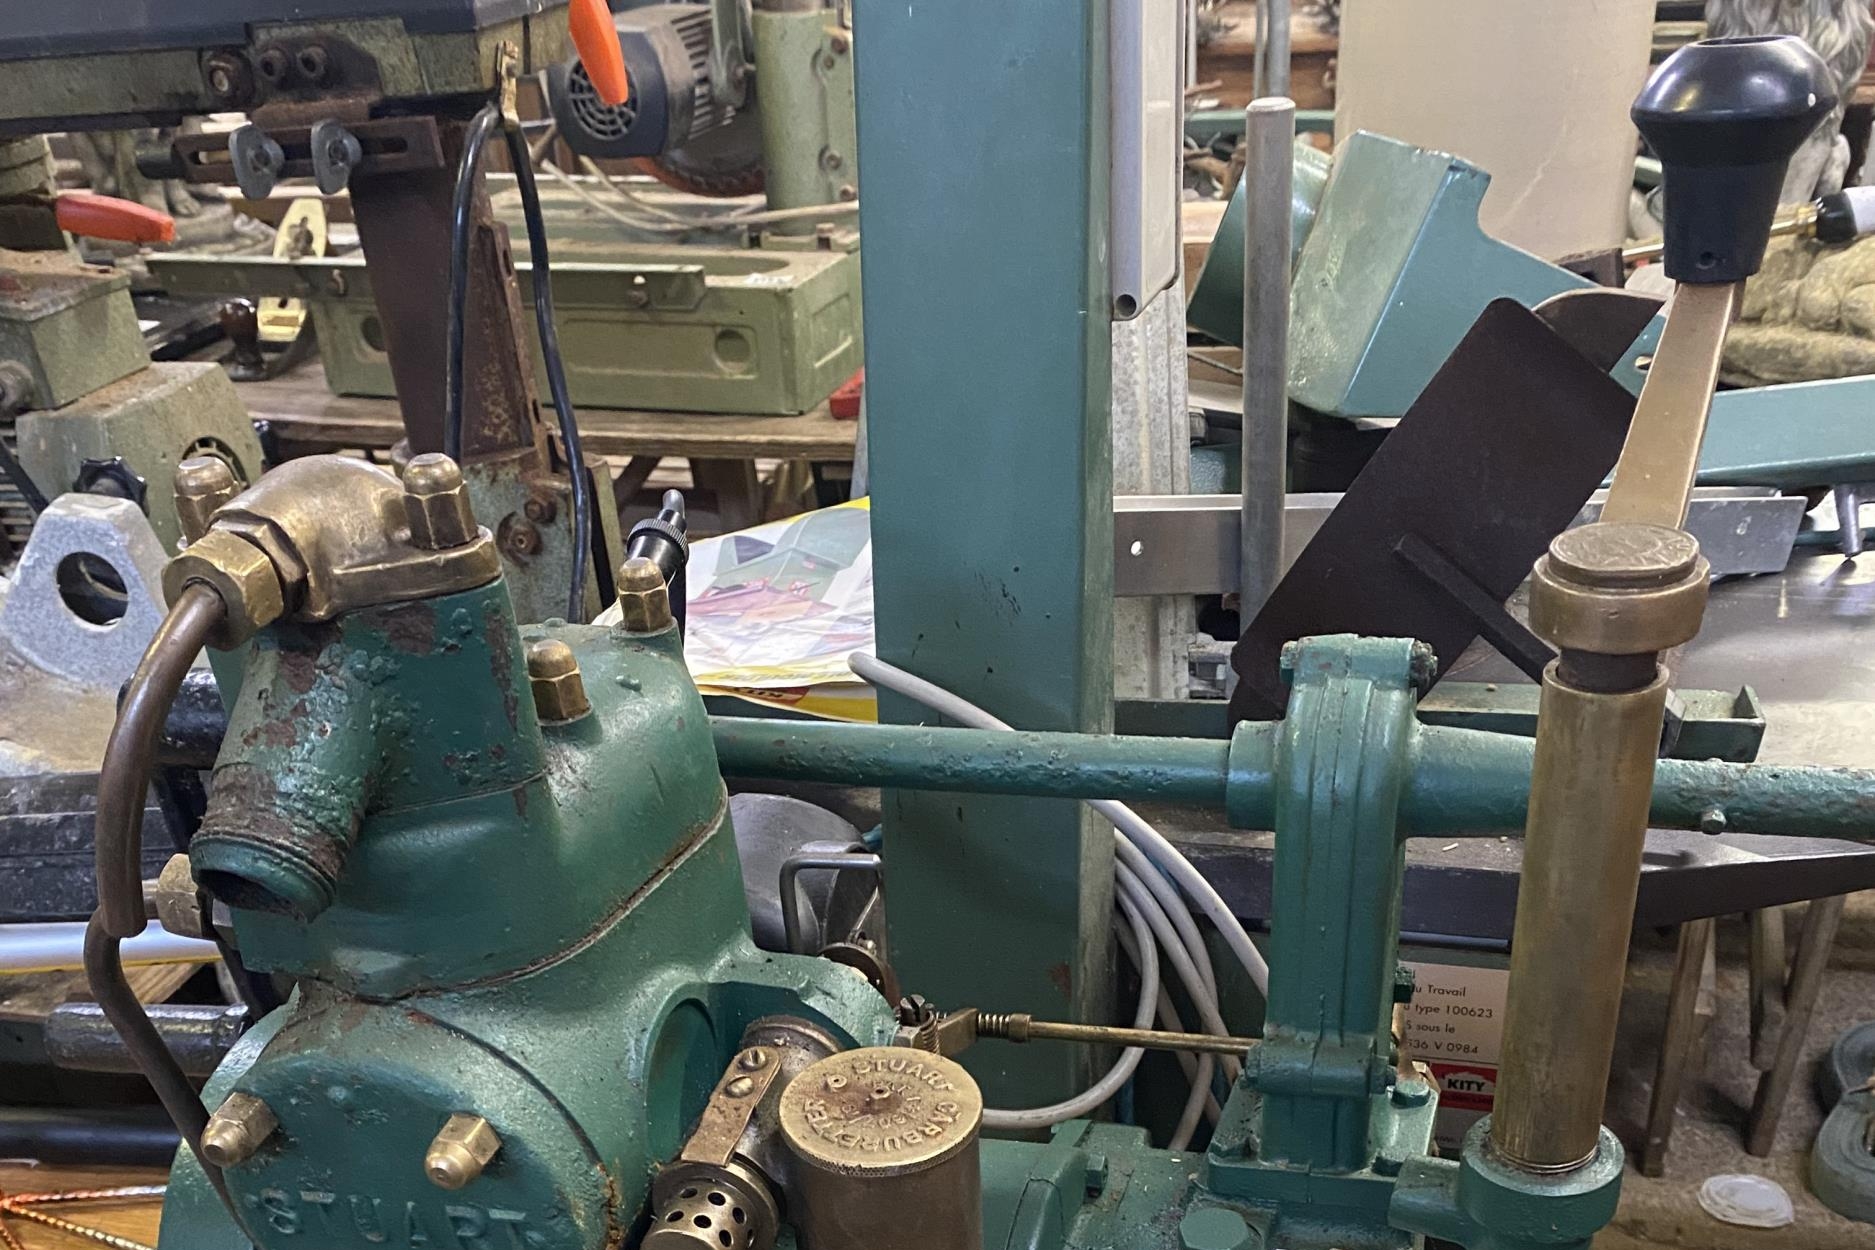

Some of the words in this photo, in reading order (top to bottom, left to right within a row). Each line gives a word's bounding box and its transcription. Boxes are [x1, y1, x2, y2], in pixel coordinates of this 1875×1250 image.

[1428, 984, 1466, 997] Travail
[1416, 1004, 1440, 1015] type
[1447, 1005, 1493, 1018] 100623
[1416, 1023, 1440, 1033] sous
[1445, 1023, 1455, 1033] le
[1434, 1042, 1443, 1051] V
[1447, 1043, 1478, 1054] 0984
[1447, 1079, 1486, 1092] KITY
